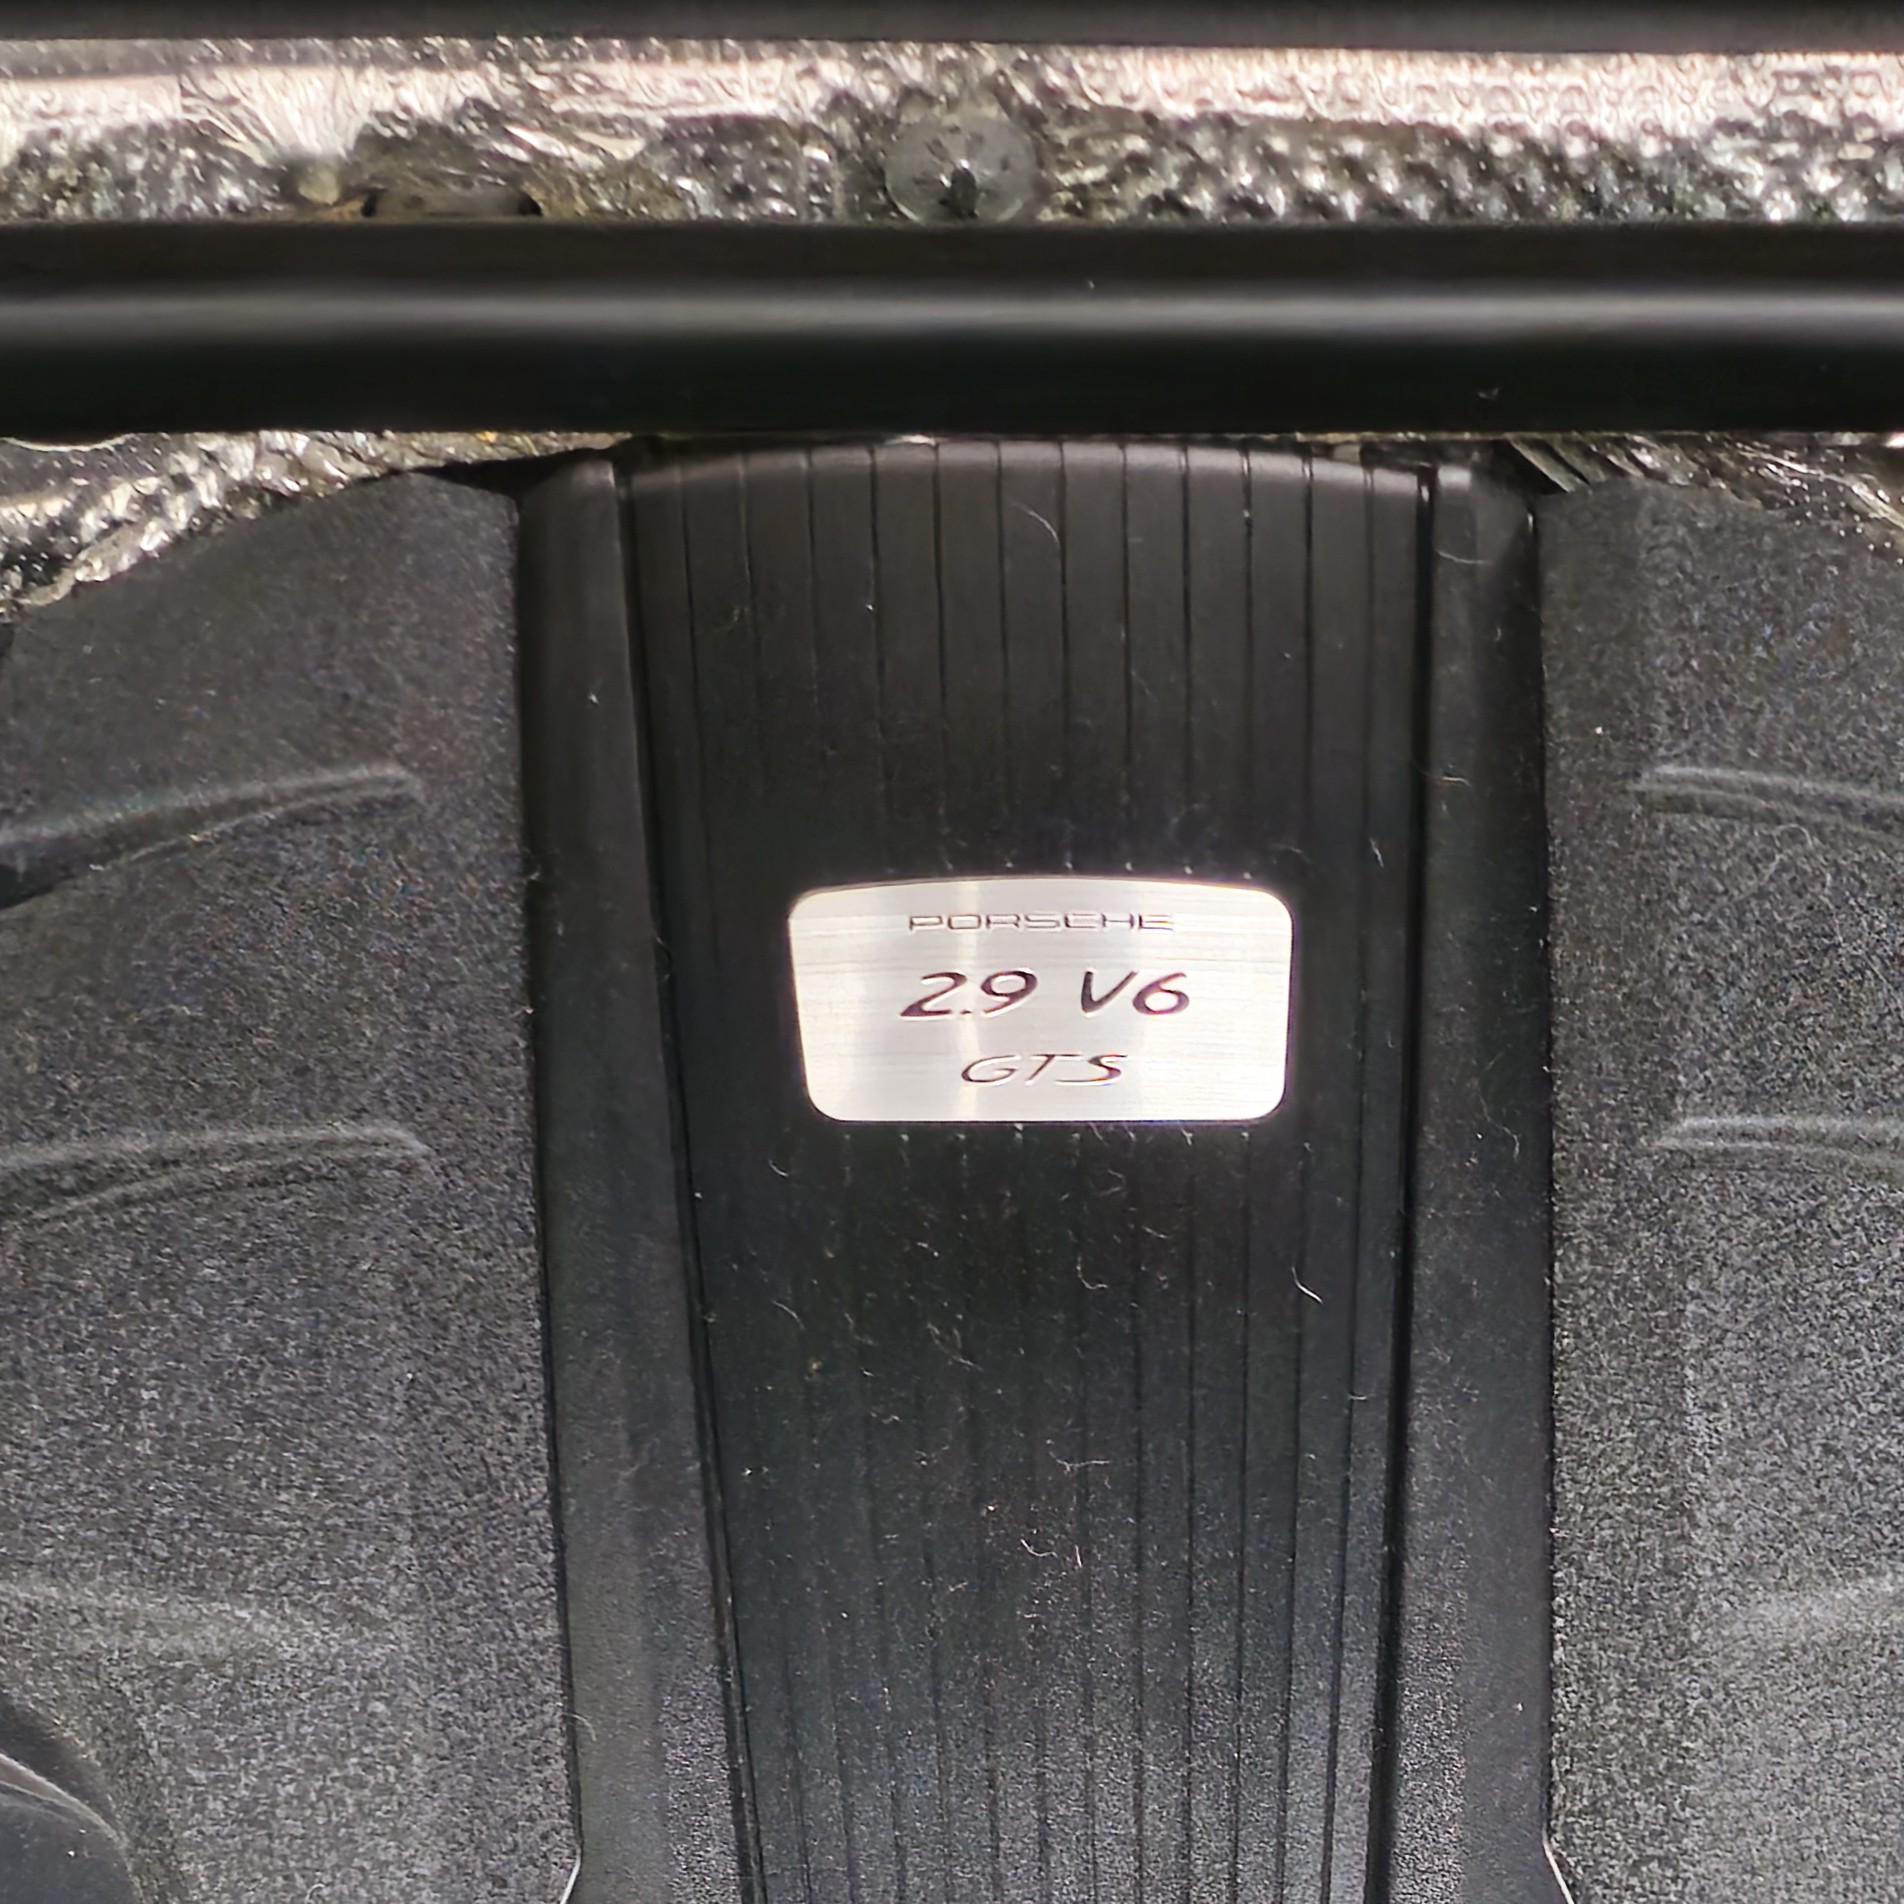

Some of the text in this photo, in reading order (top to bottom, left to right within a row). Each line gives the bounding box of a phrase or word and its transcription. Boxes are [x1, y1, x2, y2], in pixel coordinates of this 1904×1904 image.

[907, 912, 1174, 932] PORSCHE
[900, 967, 1191, 1020] 2.9 V6
[960, 1052, 1129, 1085] GTS
